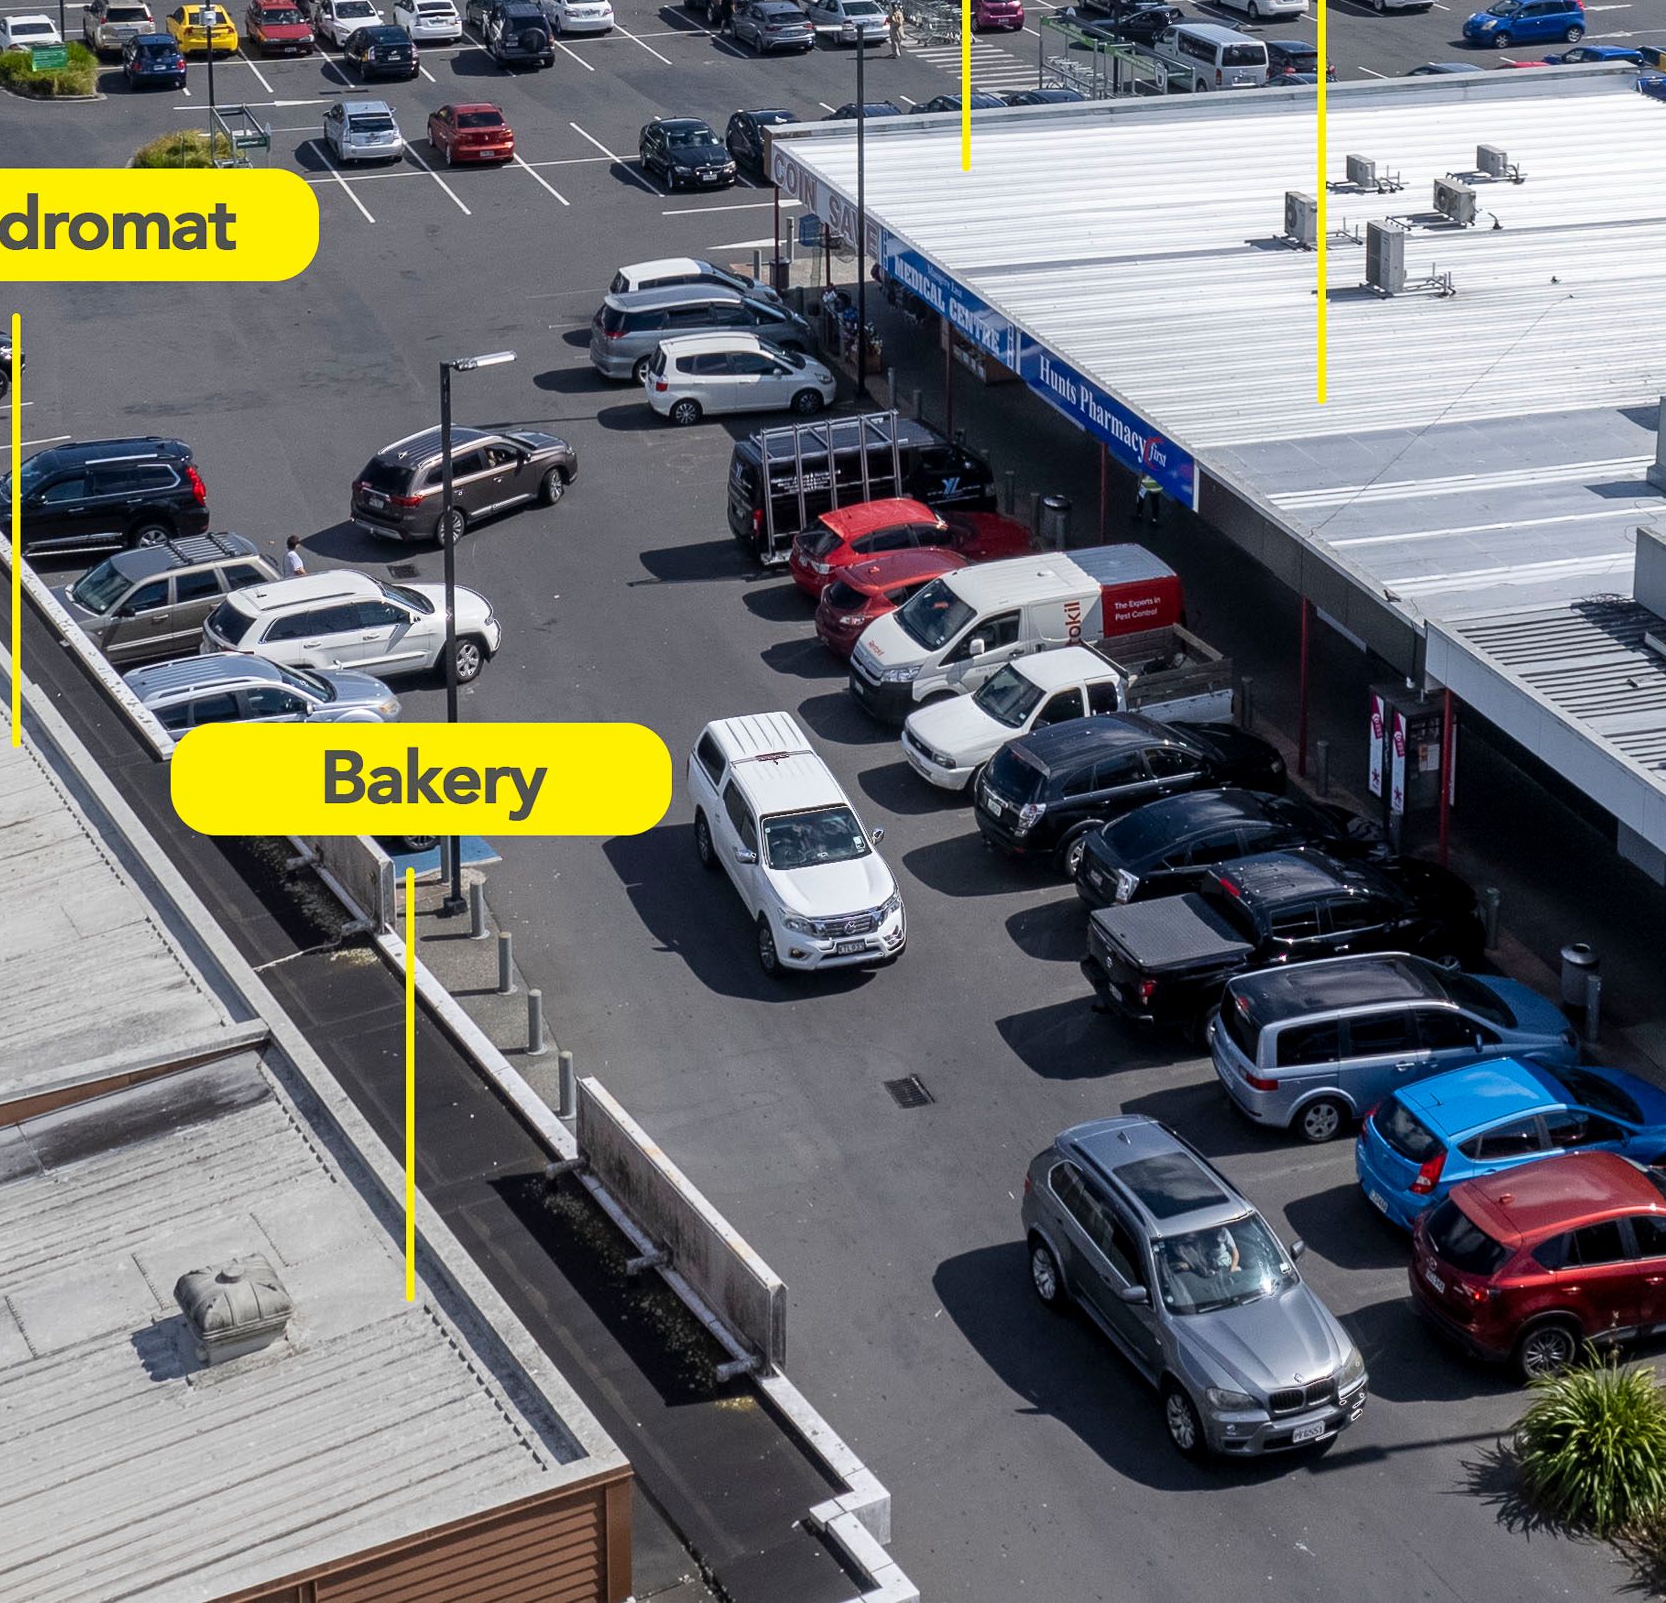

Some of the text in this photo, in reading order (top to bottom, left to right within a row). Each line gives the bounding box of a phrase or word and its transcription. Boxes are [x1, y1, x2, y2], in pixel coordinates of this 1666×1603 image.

[773, 153, 817, 211] COIN
[894, 256, 1000, 354] MEDICAL CENTRE
[1039, 355, 1077, 406] Hunts
[1080, 384, 1147, 464] Pharmacy
[1114, 597, 1161, 610] The Experts in
[1115, 608, 1158, 621] Pest Control
